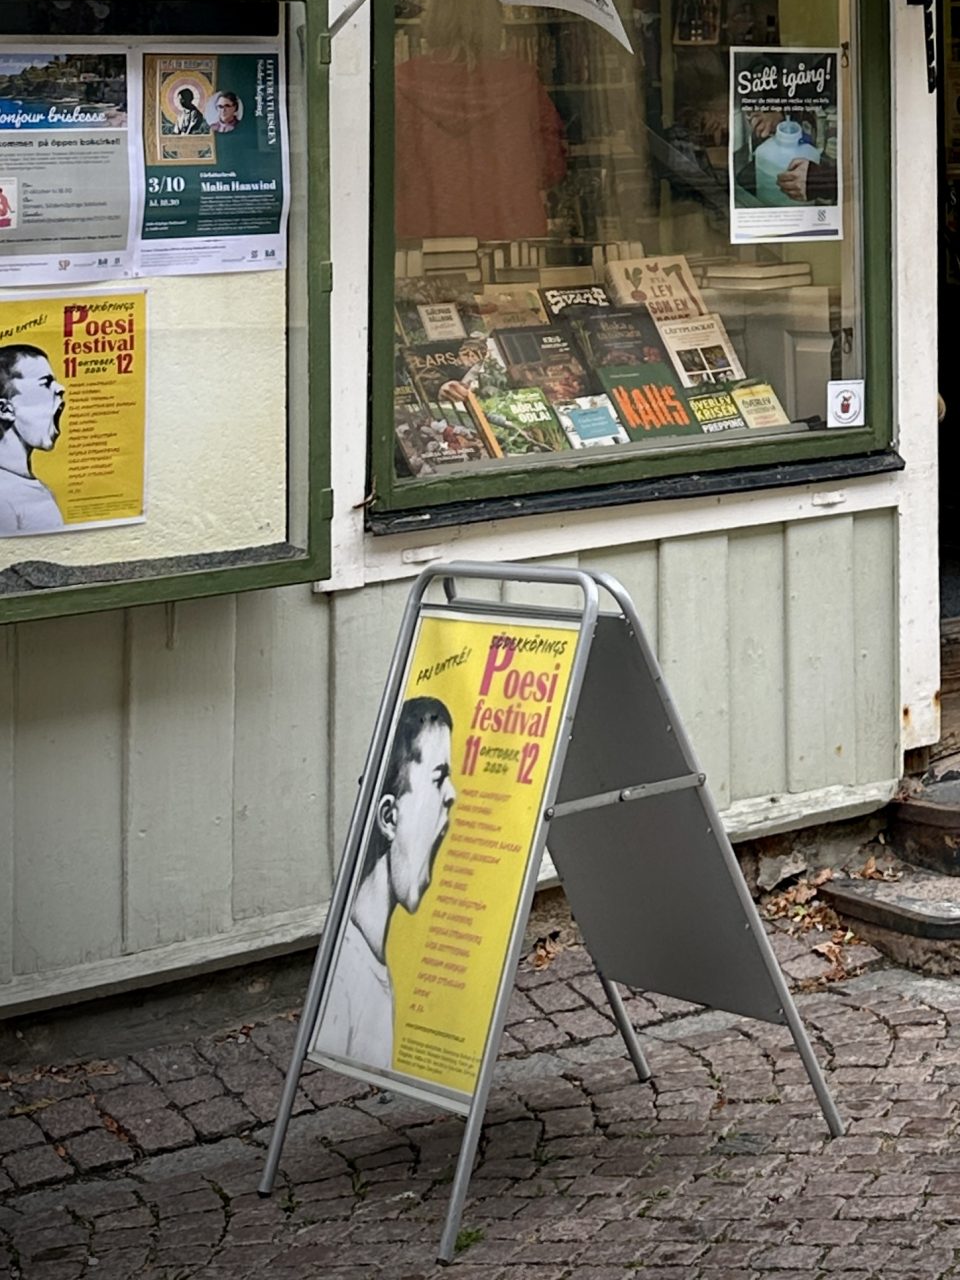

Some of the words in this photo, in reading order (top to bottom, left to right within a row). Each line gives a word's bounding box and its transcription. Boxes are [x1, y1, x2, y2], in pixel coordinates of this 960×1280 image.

[737, 65, 778, 95] Sätt
[782, 57, 832, 98] igång!
[0, 109, 46, 129] onjour
[148, 175, 186, 194] 3/10
[544, 286, 610, 315] SVAMP
[63, 304, 135, 338] Poesi
[63, 334, 135, 356] festival
[63, 357, 77, 379] 11
[116, 353, 134, 375] 12
[414, 352, 457, 369] LARS
[695, 404, 738, 420] KRISEN
[701, 418, 746, 434] PREPPING
[488, 631, 568, 658] SÖDERKÖPINGS
[478, 634, 561, 704] Poesi
[470, 698, 552, 739] festival
[460, 735, 482, 777] 11
[516, 741, 541, 786] 12
